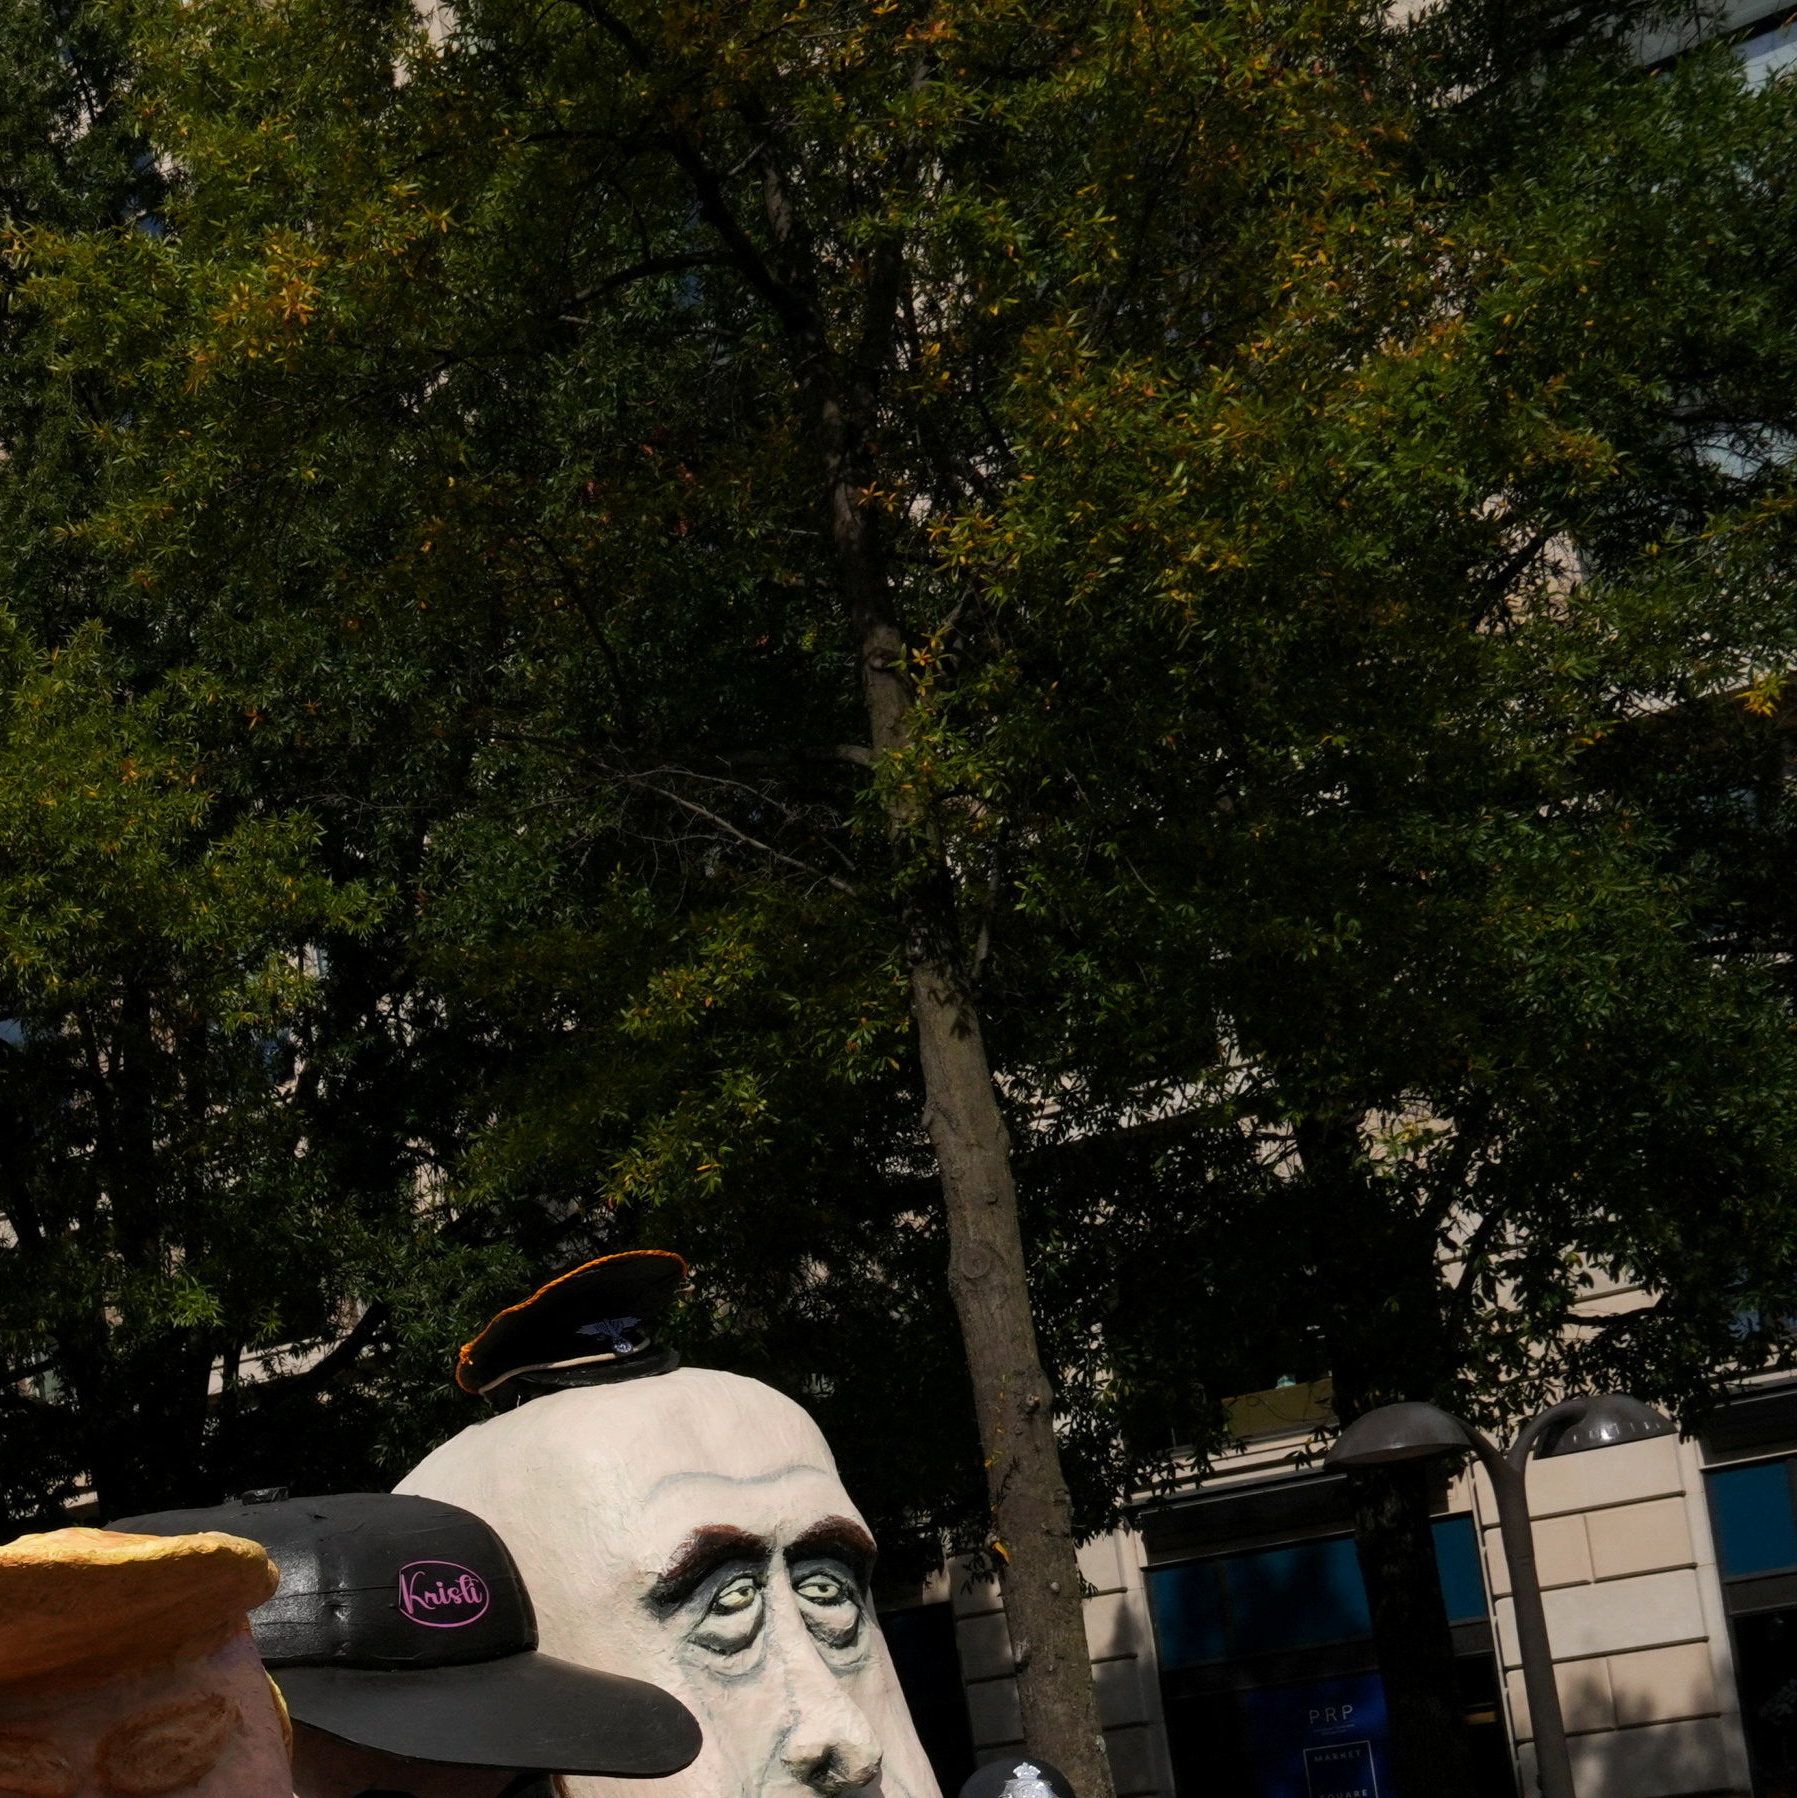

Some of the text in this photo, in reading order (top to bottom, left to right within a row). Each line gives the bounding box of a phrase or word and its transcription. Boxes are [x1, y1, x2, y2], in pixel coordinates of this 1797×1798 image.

[400, 1570, 483, 1615] Kristi
[1308, 1703, 1354, 1725] PRP
[1313, 1749, 1362, 1763] MARKET
